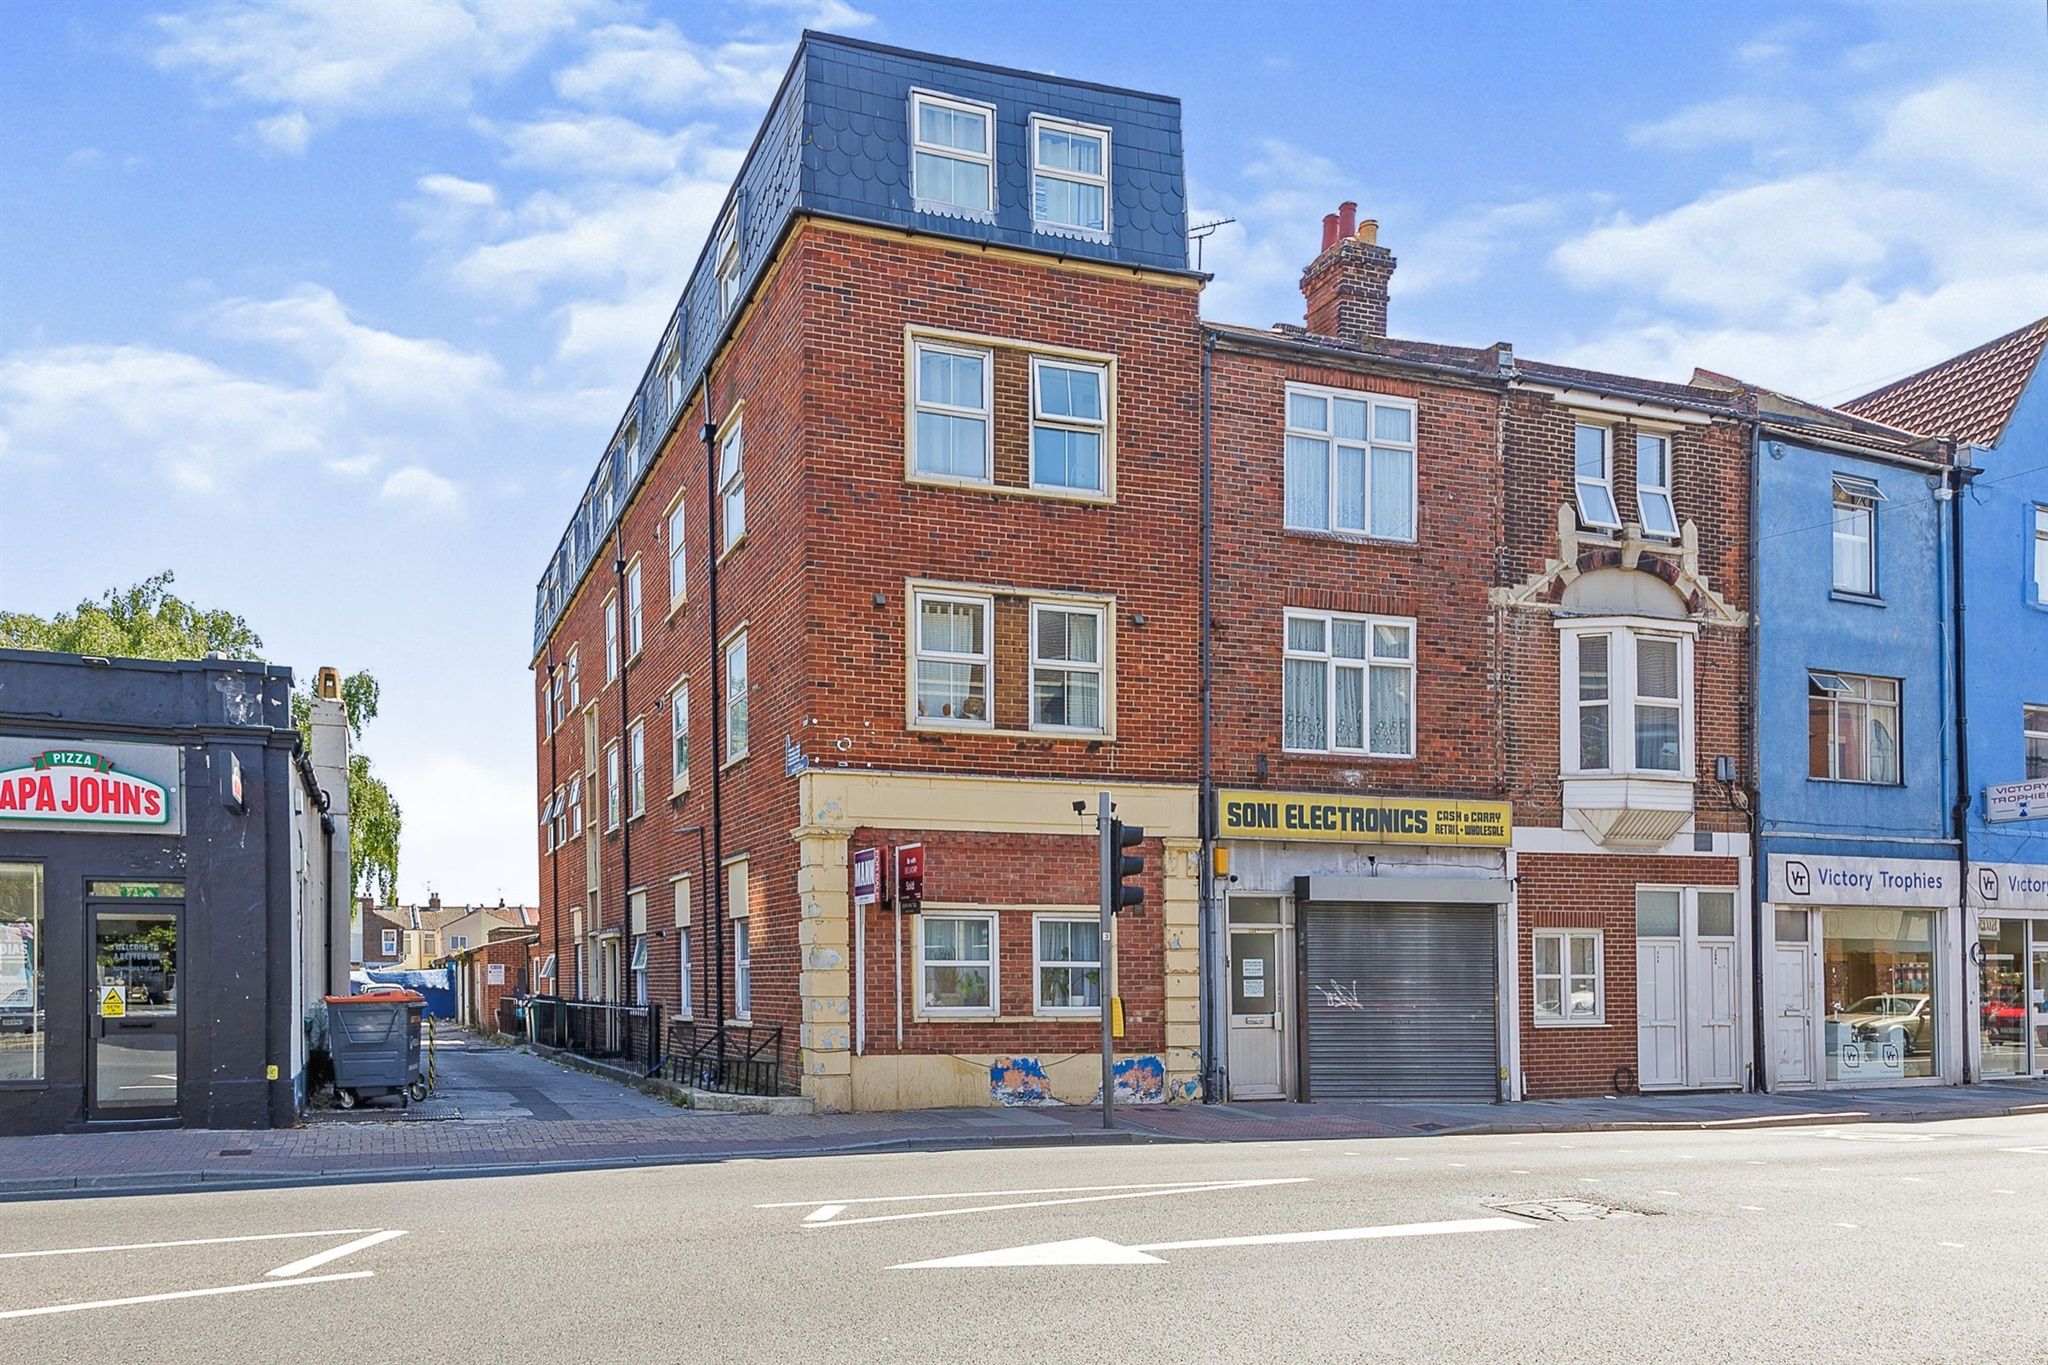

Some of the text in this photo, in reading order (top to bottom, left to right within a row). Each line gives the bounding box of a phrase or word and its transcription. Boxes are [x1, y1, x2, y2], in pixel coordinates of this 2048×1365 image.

[53, 753, 92, 765] PIZZA
[61, 776, 161, 816] JOHN'S
[1991, 792, 2048, 804] TROPHIE
[1227, 802, 1428, 834] SONI ELECTRONICS
[1436, 810, 1461, 822] CASH
[1471, 811, 1502, 823] CARRY
[1434, 824, 1505, 837] RETAIL WHOLESALE
[1818, 868, 1873, 891] Victory
[1879, 871, 1943, 893] Trophies
[2008, 875, 2048, 896] Victor
[114, 943, 148, 951] WELCOME
